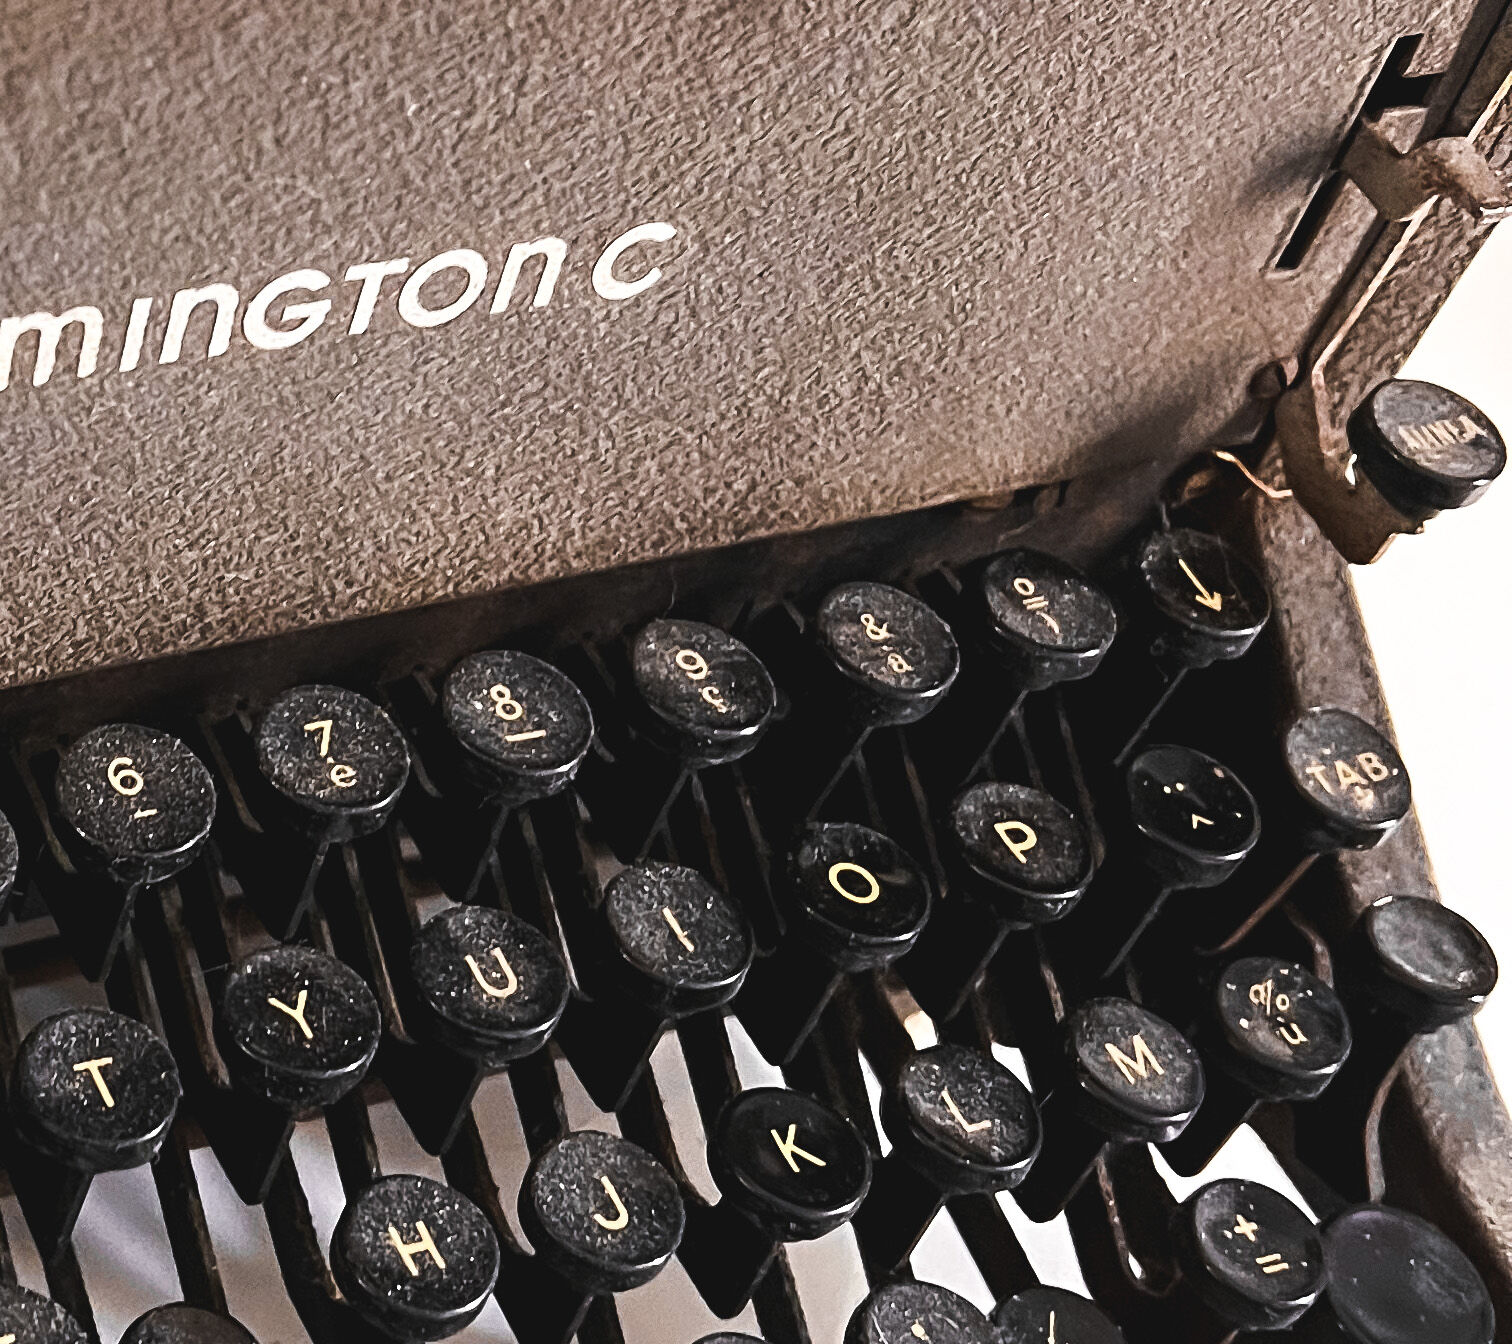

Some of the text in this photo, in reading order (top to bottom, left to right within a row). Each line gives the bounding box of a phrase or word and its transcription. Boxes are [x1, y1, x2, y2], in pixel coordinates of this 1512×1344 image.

[592, 222, 678, 300] C
[860, 613, 895, 641] &
[675, 649, 708, 680] 9
[489, 683, 523, 721] 8
[303, 719, 333, 758] 7
[107, 755, 144, 796] 6
[993, 821, 1038, 864] P
[828, 862, 880, 904] O
[464, 947, 518, 998] U
[267, 989, 314, 1039] Y
[72, 1056, 115, 1108] T
[1104, 1033, 1166, 1086] M
[941, 1089, 992, 1133] L
[770, 1123, 827, 1173] K
[592, 1175, 629, 1230] J
[385, 1220, 446, 1277] H
